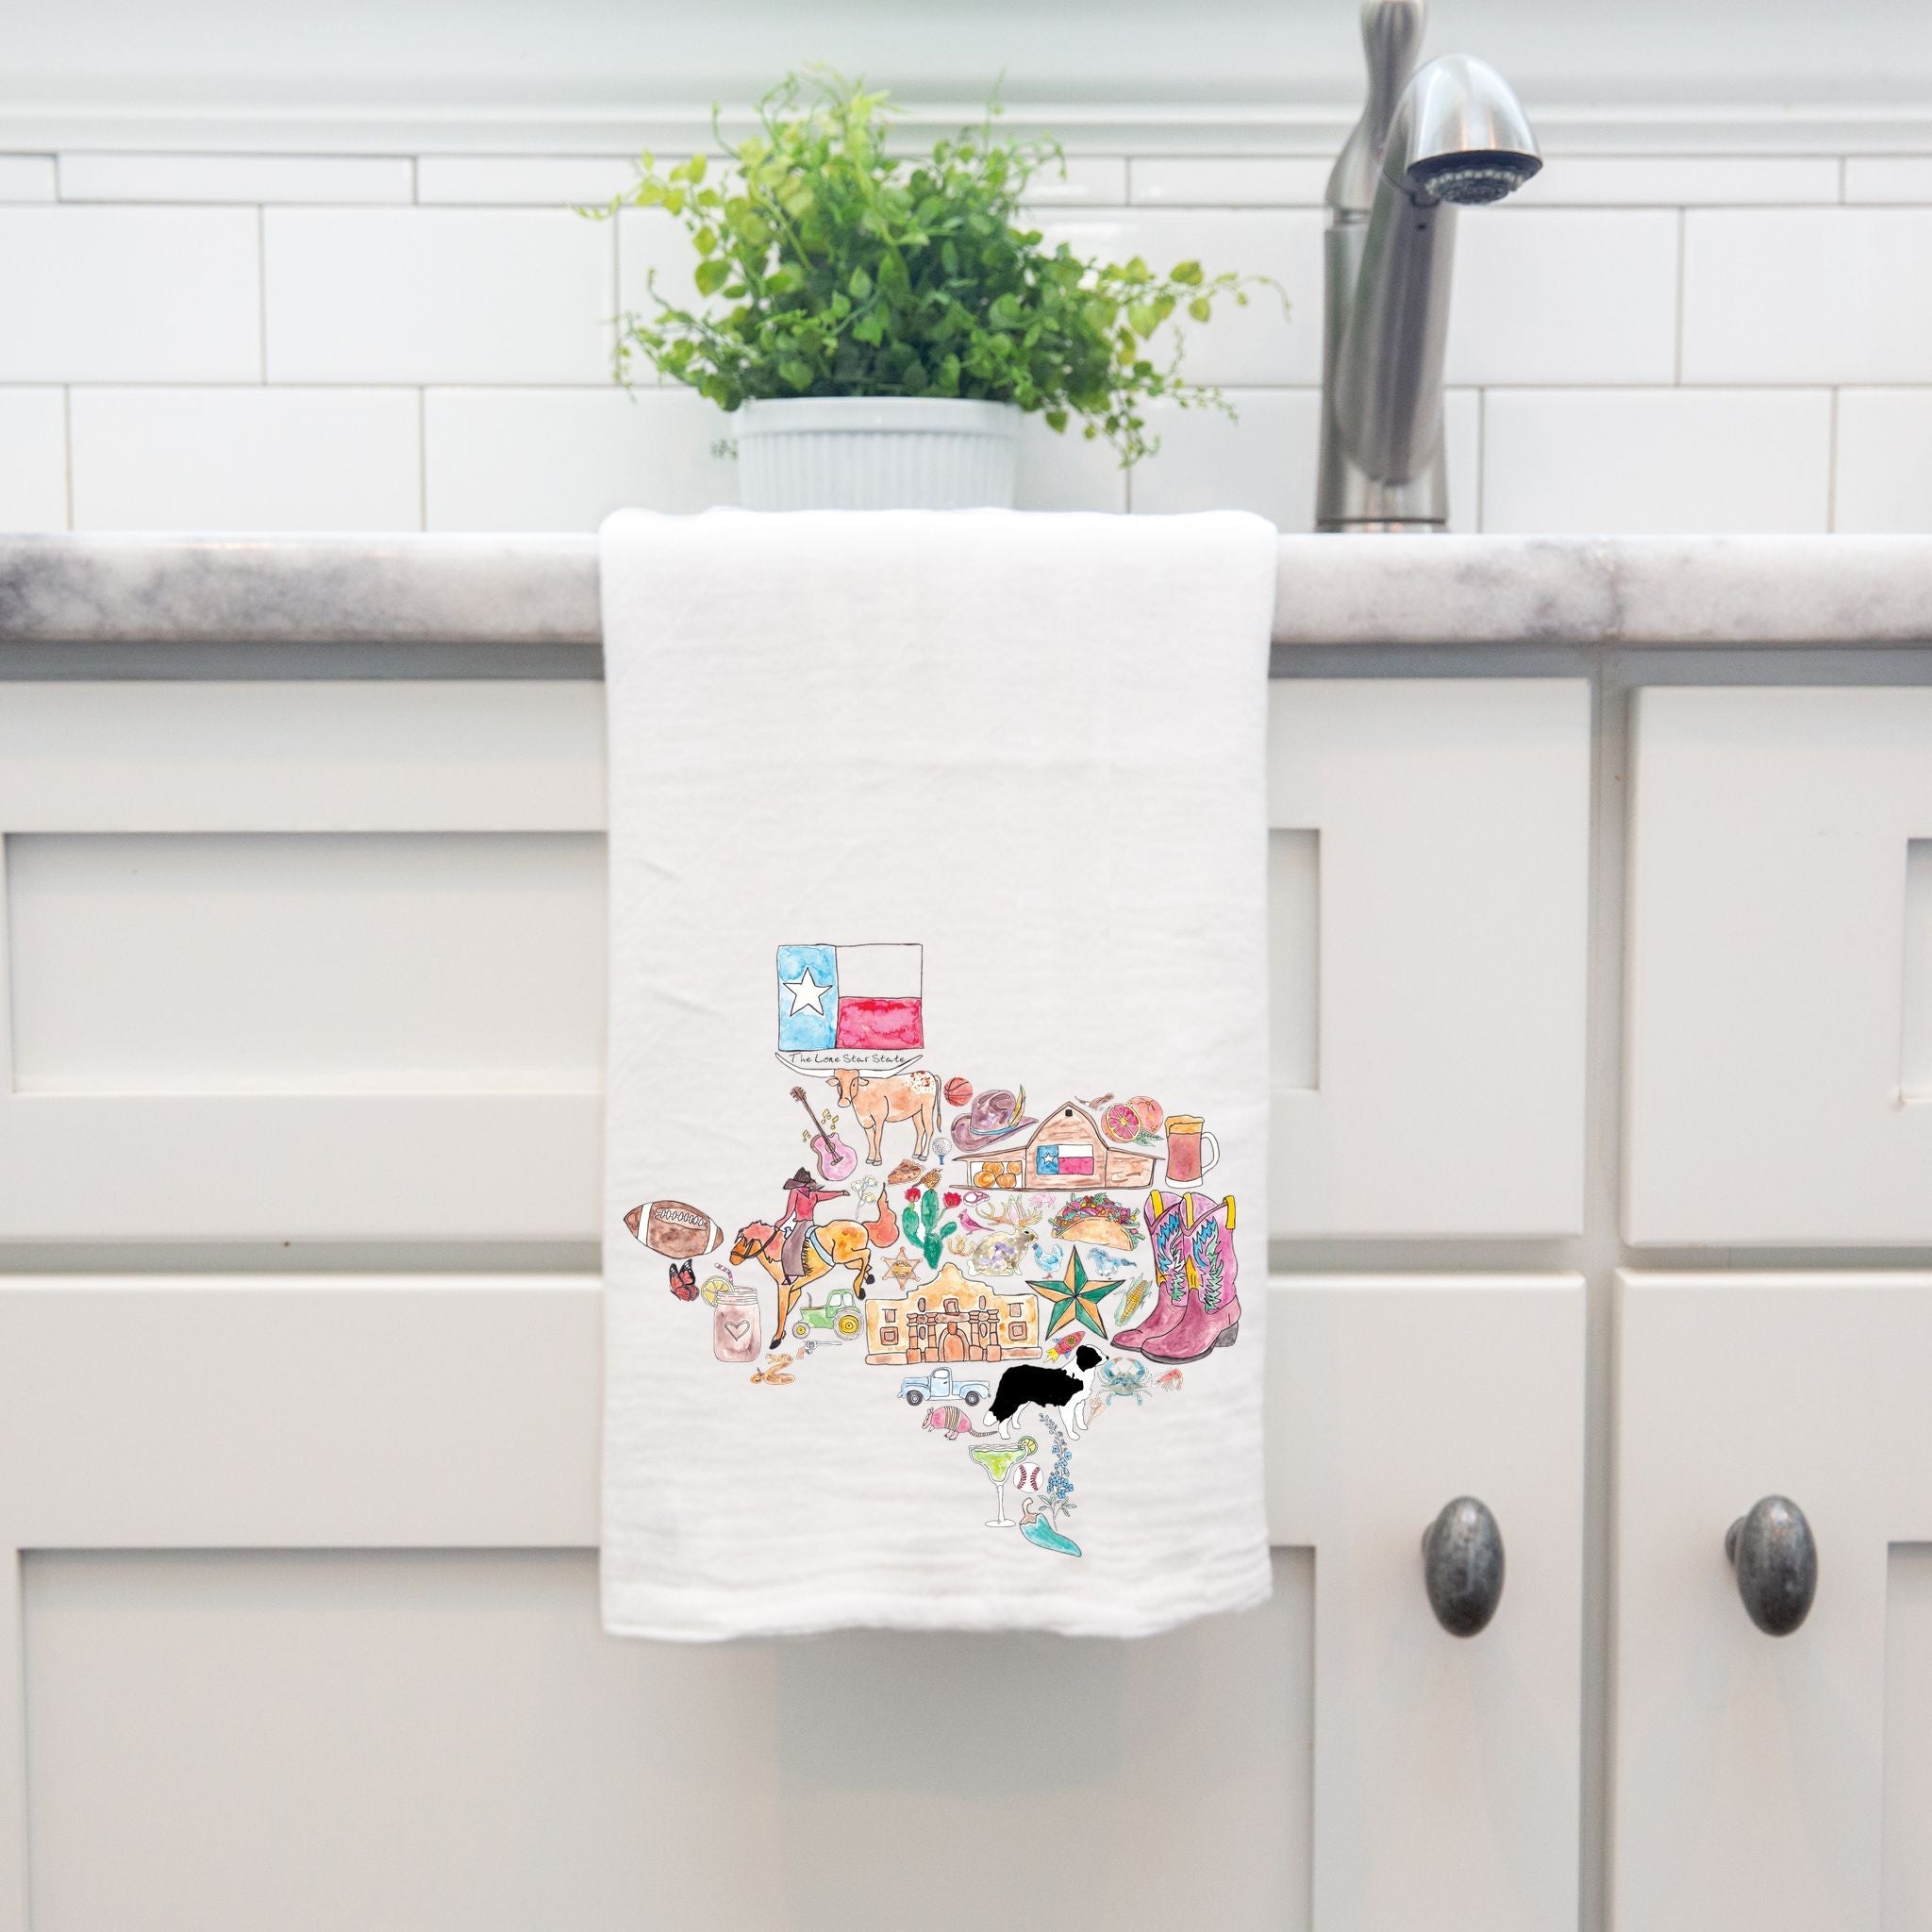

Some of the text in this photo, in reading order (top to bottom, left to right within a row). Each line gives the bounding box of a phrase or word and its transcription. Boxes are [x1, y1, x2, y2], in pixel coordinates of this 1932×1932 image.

[789, 1052, 907, 1063] The Lone Star State
